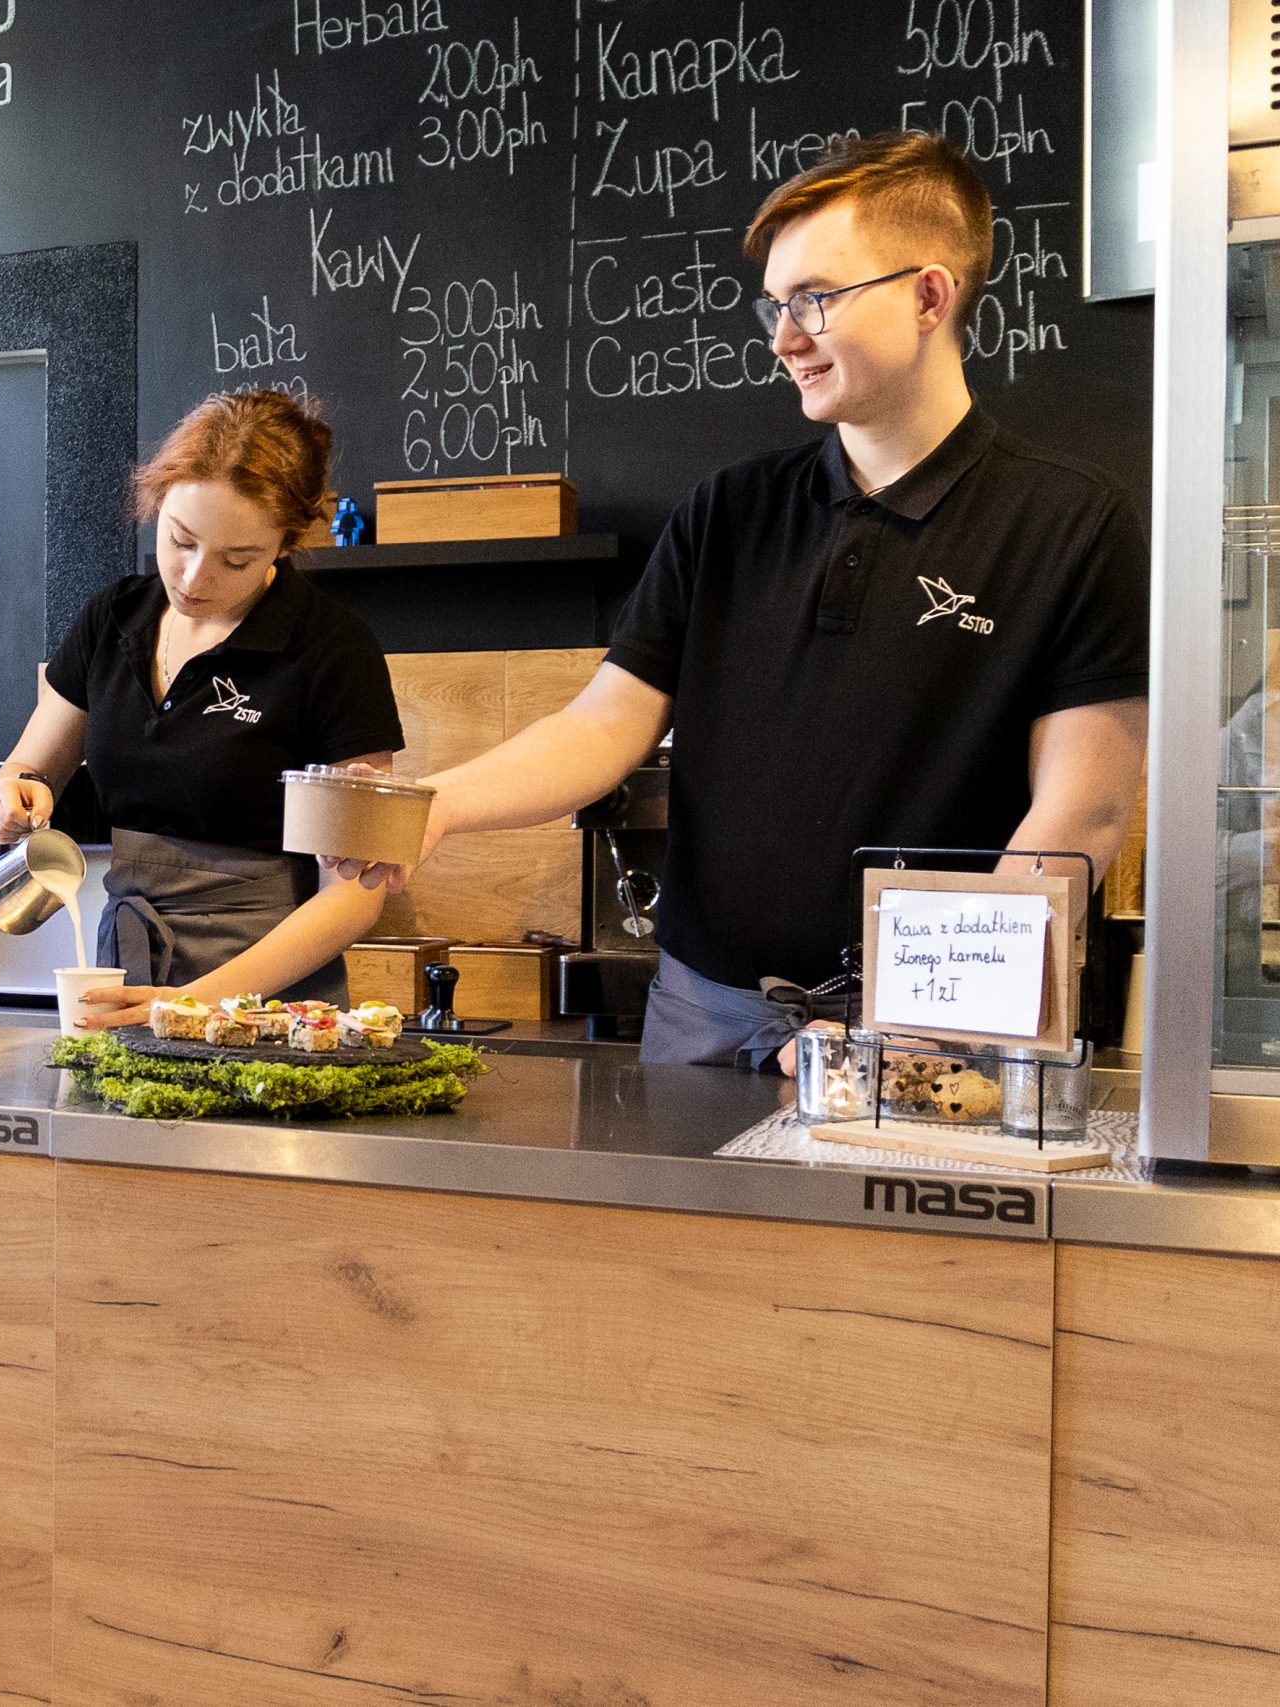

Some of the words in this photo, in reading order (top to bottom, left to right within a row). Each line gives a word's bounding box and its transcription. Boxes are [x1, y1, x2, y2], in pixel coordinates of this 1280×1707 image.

[597, 2, 801, 121] Kanapka
[182, 68, 306, 171] zwykła
[184, 182, 208, 214] z
[218, 133, 395, 205] dodatkami
[591, 117, 728, 218] Zupa
[309, 208, 422, 313] Kawy
[584, 239, 743, 325] Ciasto
[893, 916, 931, 937] Kawa
[940, 923, 949, 934] z
[953, 910, 1032, 935] dodatkiem
[894, 944, 942, 974] słonego
[948, 943, 1006, 964] karmelu
[863, 1175, 1036, 1225] masa
